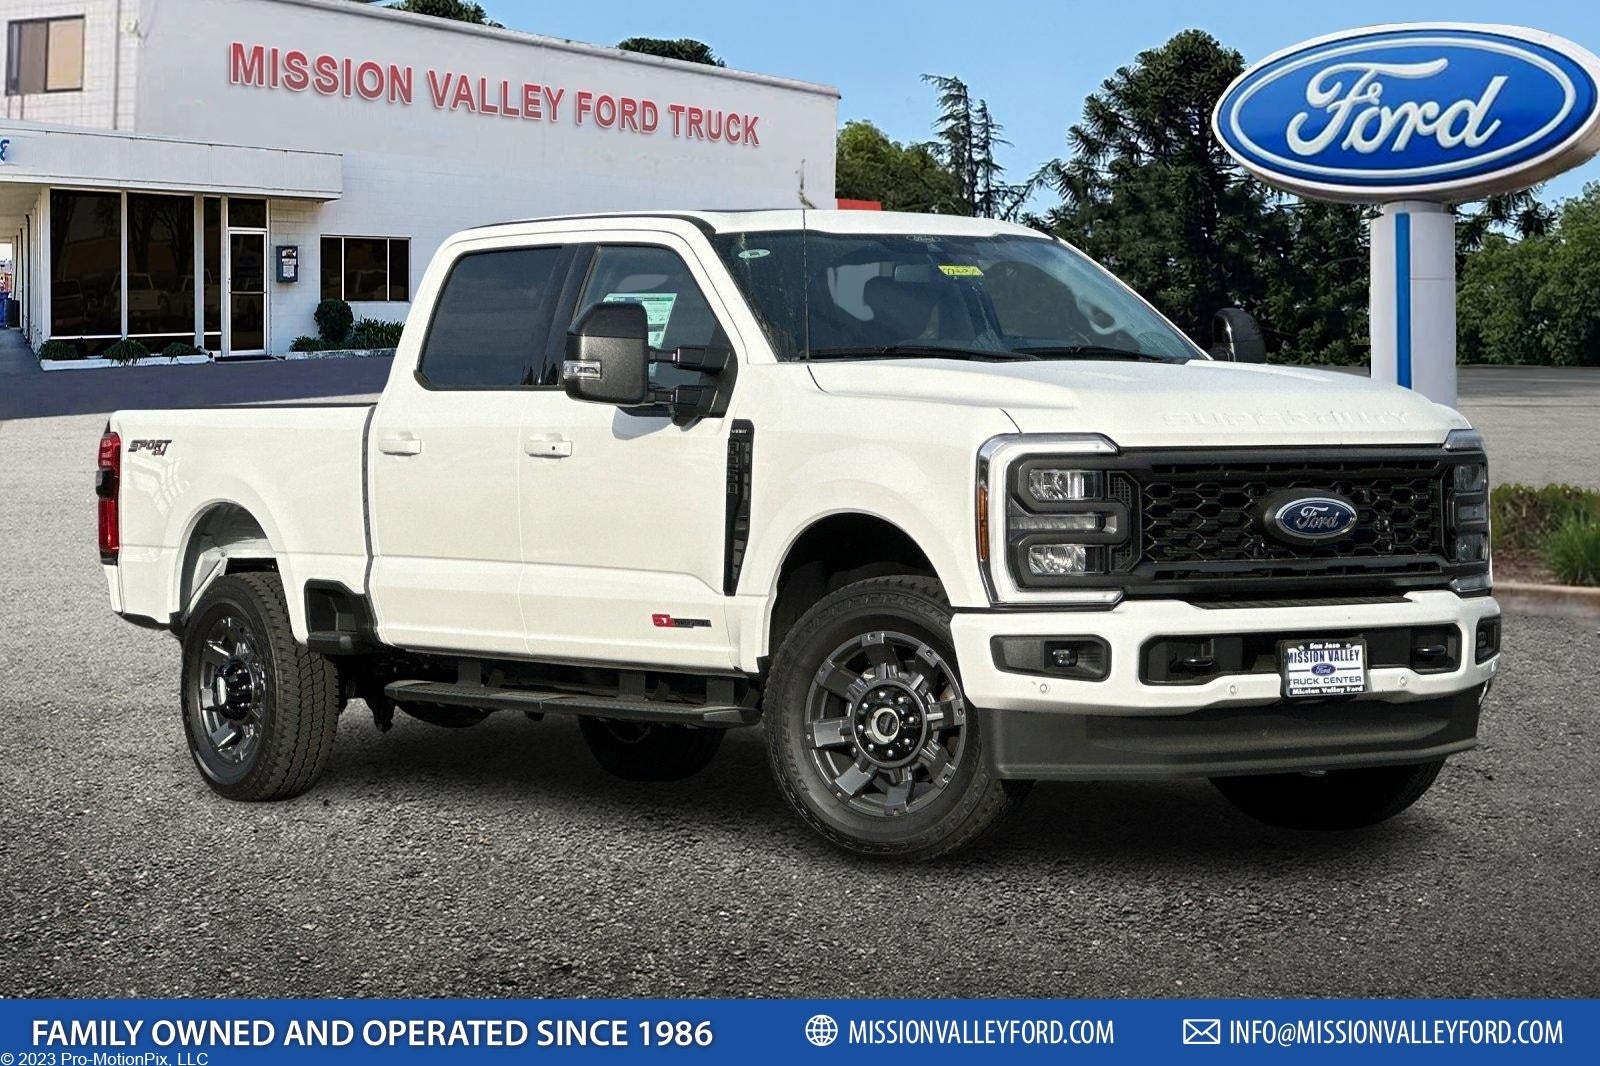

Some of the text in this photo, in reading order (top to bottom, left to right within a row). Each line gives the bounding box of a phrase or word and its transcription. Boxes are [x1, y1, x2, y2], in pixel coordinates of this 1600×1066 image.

[229, 41, 760, 146] MISSION VALLEY FORD TRUCK
[1286, 57, 1509, 156] Ford
[128, 440, 172, 456] SPORT
[1297, 505, 1340, 530] Ford
[1287, 650, 1360, 664] MISSION VALLEY
[1315, 665, 1332, 674] Ford
